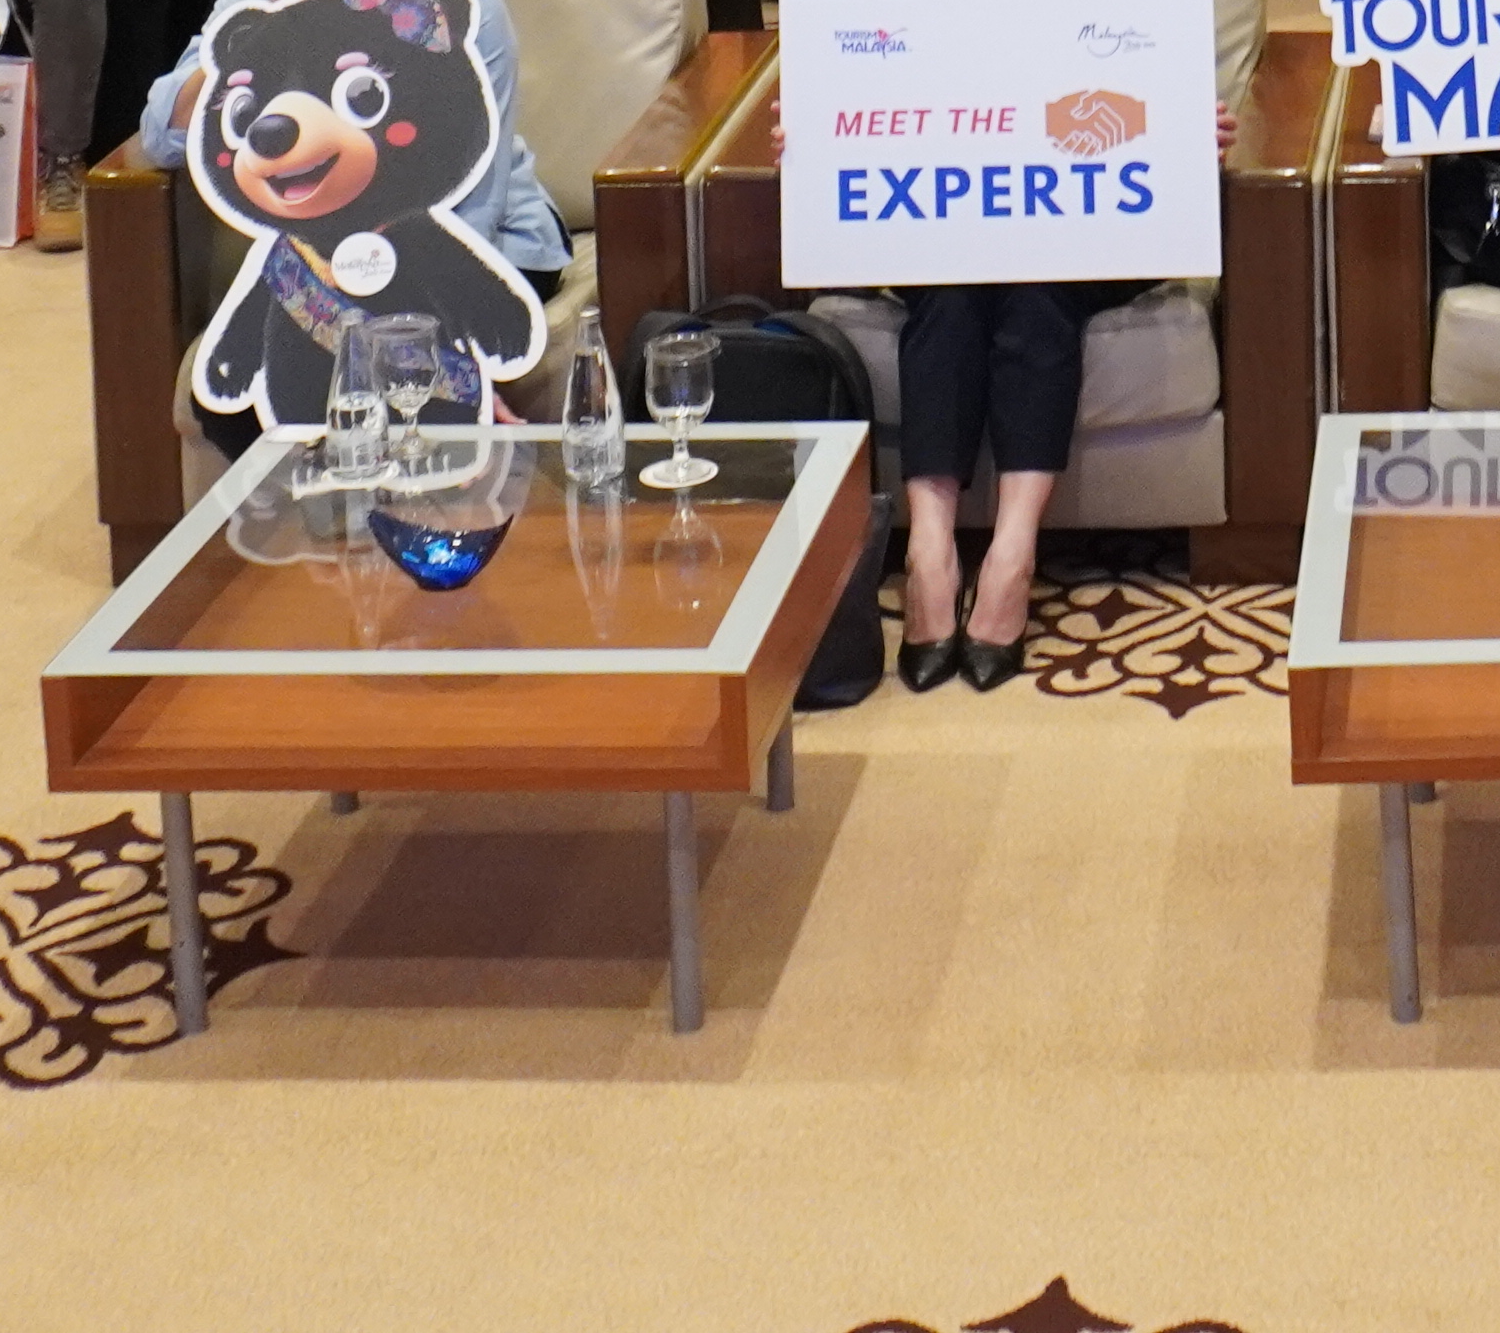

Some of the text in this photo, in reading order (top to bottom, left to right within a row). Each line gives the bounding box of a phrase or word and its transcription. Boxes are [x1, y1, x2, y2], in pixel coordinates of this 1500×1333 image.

[841, 40, 906, 58] MALAYSIA
[834, 107, 1016, 137] MEET THE
[838, 162, 1153, 221] EXPERTS
